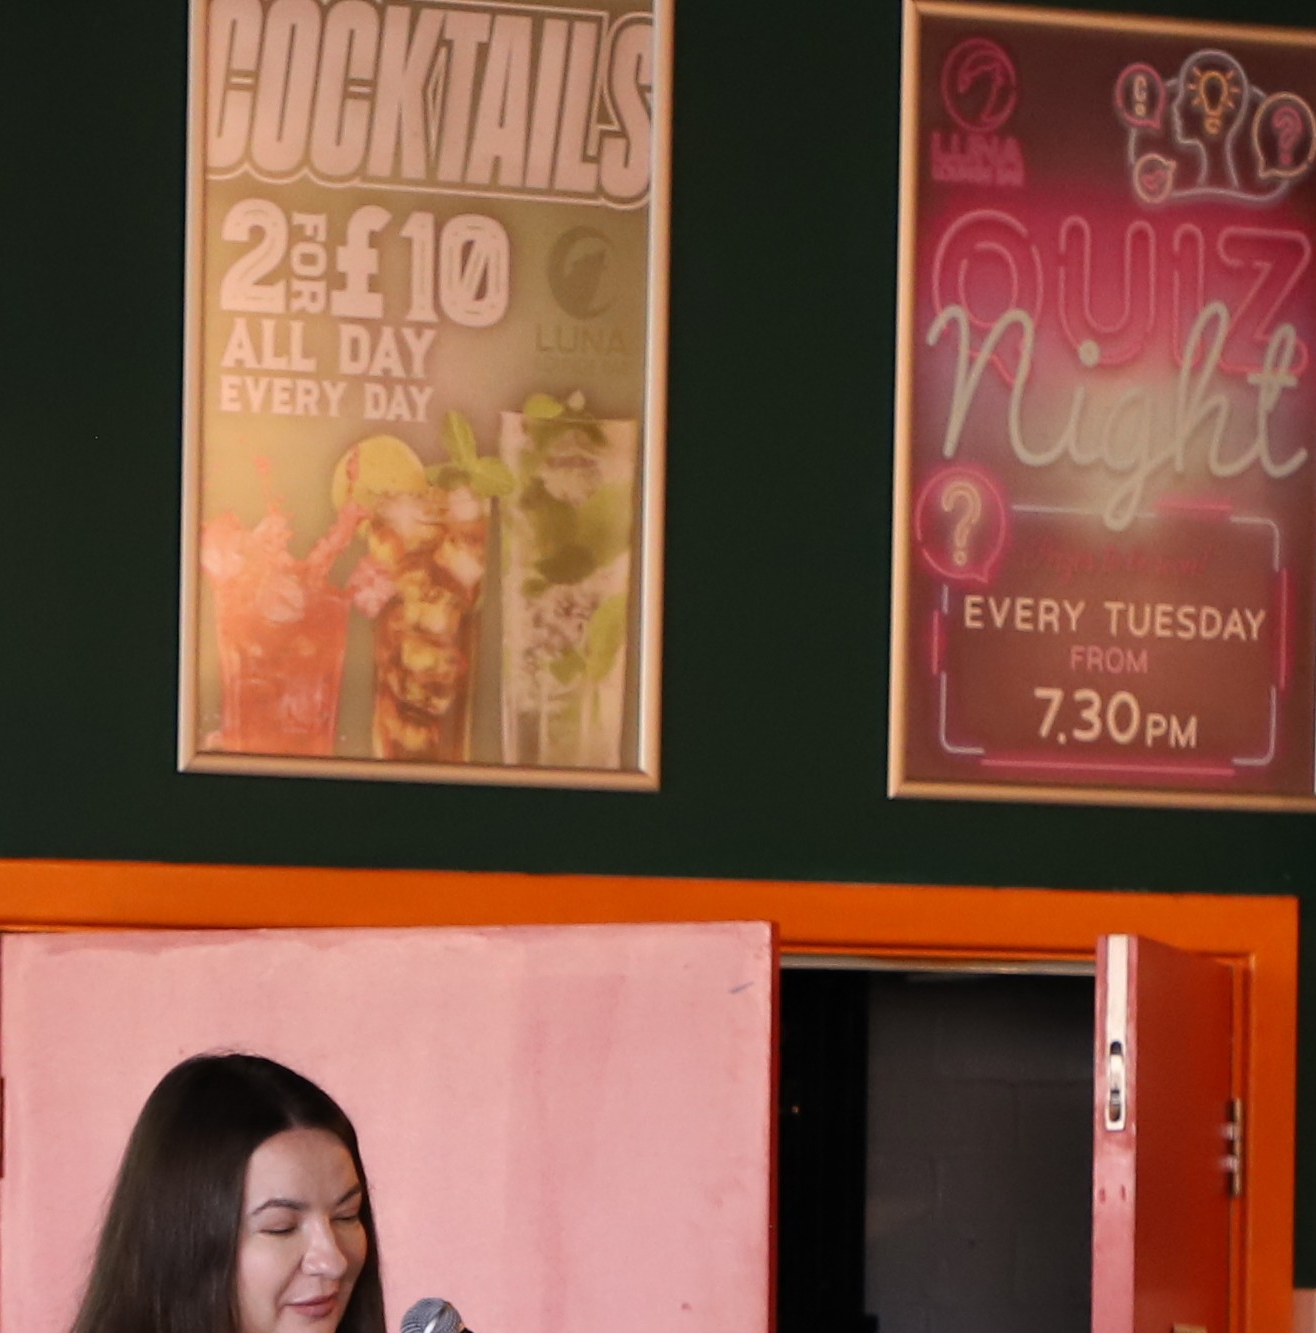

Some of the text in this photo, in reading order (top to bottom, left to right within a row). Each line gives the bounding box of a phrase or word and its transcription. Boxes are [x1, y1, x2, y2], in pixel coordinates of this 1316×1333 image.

[207, 0, 655, 206] COCKTAILS
[219, 199, 511, 328] 2 FOR £10
[932, 208, 1311, 388] QUIZ
[220, 319, 439, 380] ALL DAY
[219, 376, 435, 423] EVERY DAY
[925, 301, 1309, 532] Night
[963, 594, 1266, 640] EVERY TUESDAY
[1070, 645, 1149, 674] FROM
